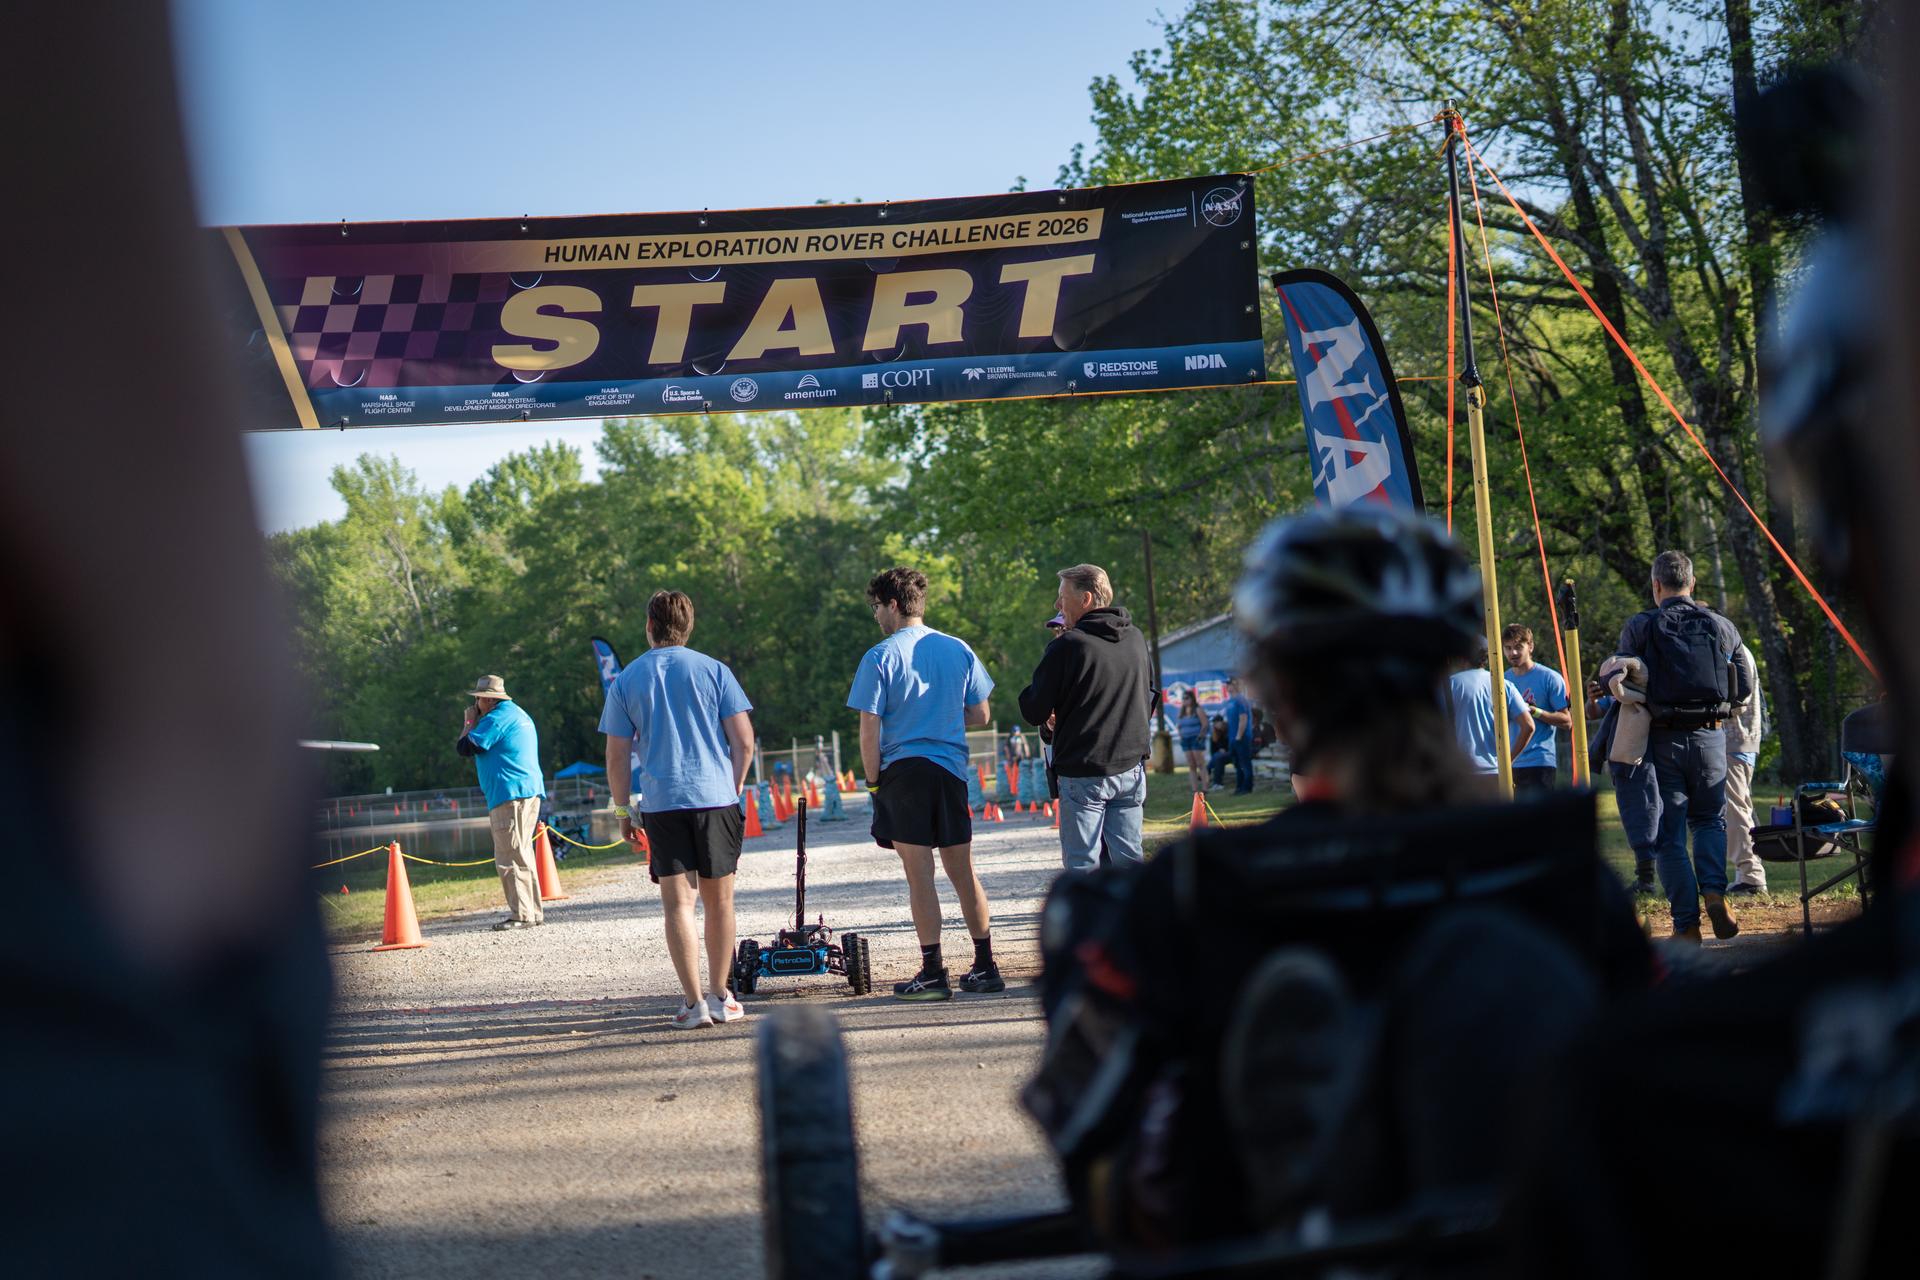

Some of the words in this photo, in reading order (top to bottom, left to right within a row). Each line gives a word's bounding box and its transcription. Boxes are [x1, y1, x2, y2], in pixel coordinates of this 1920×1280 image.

[1204, 201, 1240, 212] NASA
[1121, 211, 1144, 219] National
[544, 243, 631, 263] HUMAN
[637, 236, 799, 260] EXPLORATION
[805, 232, 885, 253] ROVER
[892, 220, 1031, 249] CHALLENGE
[1037, 217, 1089, 237] 2026
[491, 253, 1096, 372] START
[1100, 360, 1158, 372] REDSTONE
[1184, 353, 1228, 371] NDIA
[987, 366, 1016, 374] TELEDYNE
[1008, 371, 1047, 379] ENGINEERING,
[881, 368, 935, 388] COPT
[784, 388, 837, 400] amentum
